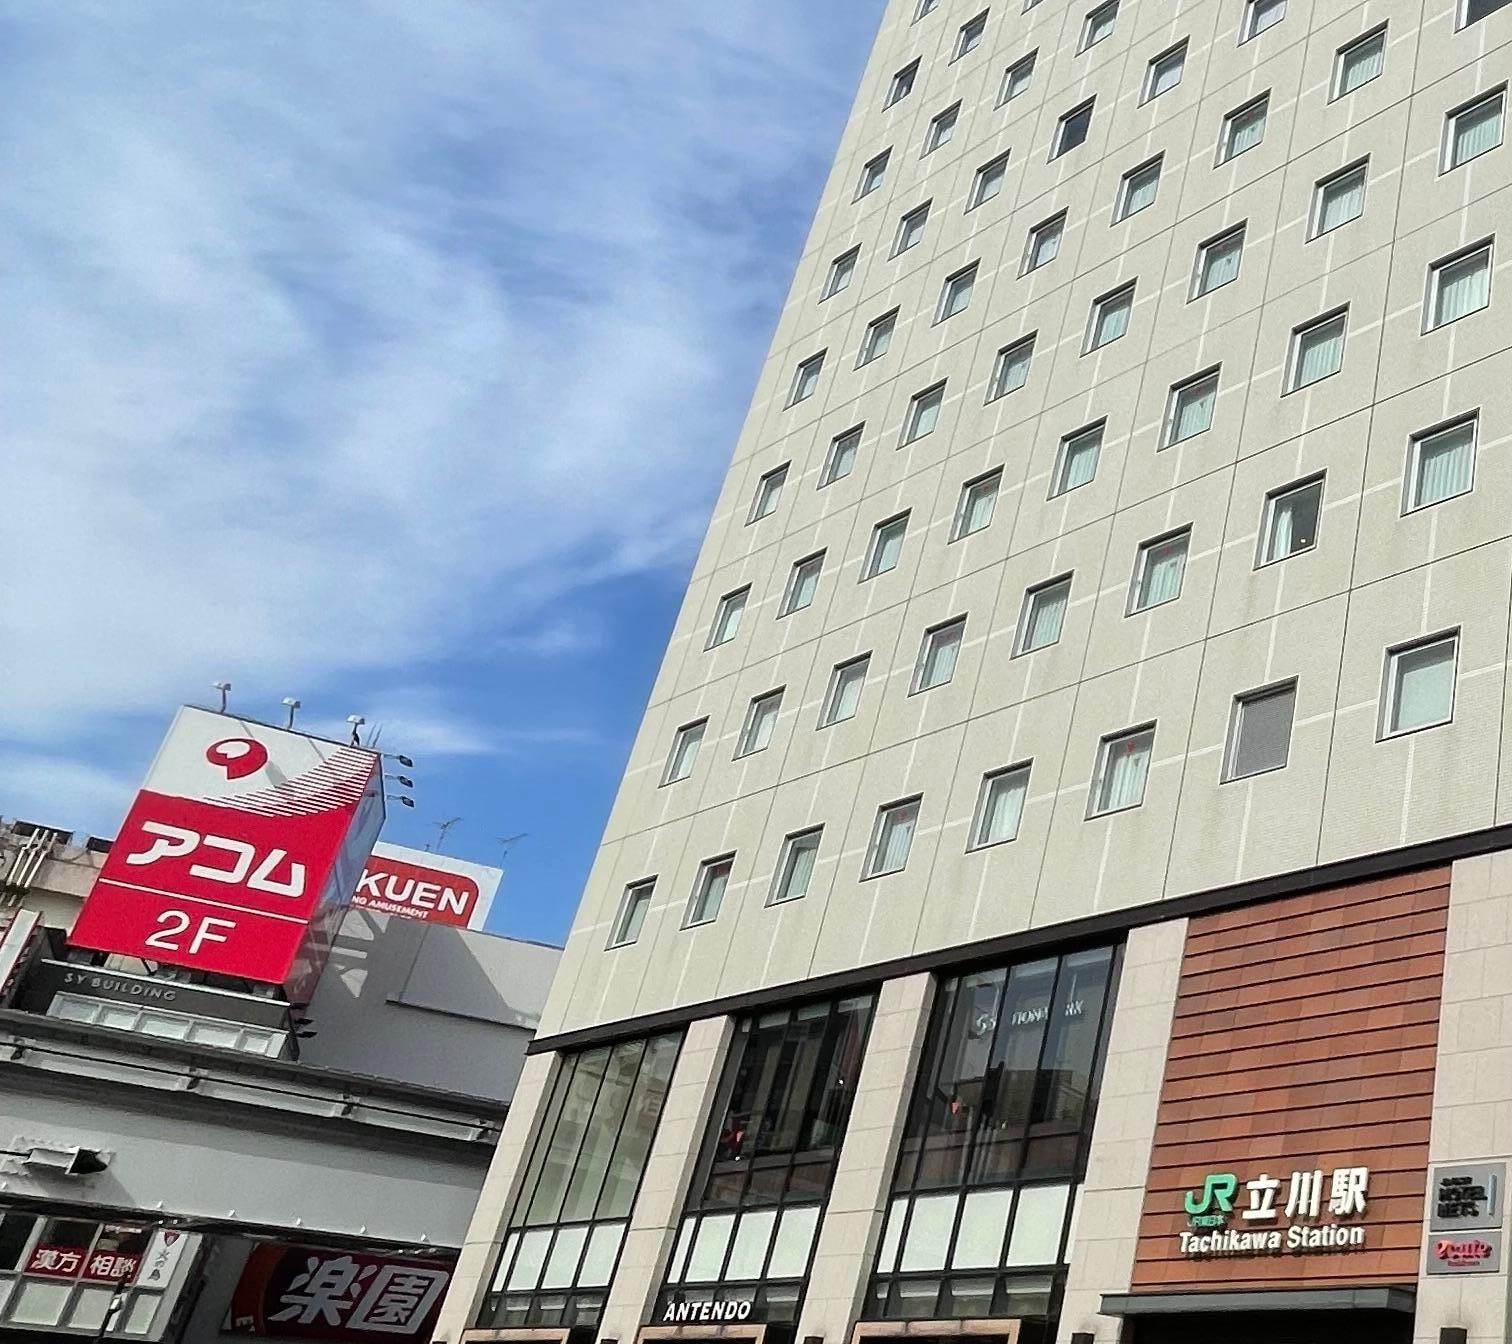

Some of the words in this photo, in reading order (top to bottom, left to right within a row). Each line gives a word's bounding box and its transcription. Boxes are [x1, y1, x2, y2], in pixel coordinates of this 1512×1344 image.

[126, 820, 306, 898] アコム
[368, 899, 429, 920] AMUSEMENT
[145, 909, 237, 955] 2F
[63, 972, 87, 985] SY
[90, 977, 177, 1002] BUILDING
[1184, 1173, 1239, 1215] JR
[1241, 1166, 1369, 1220] 立川駅
[1179, 1229, 1282, 1254] Tachikawa
[1286, 1223, 1366, 1249] Station
[267, 1256, 450, 1334] 楽園
[662, 1301, 751, 1322] ANTENDO
